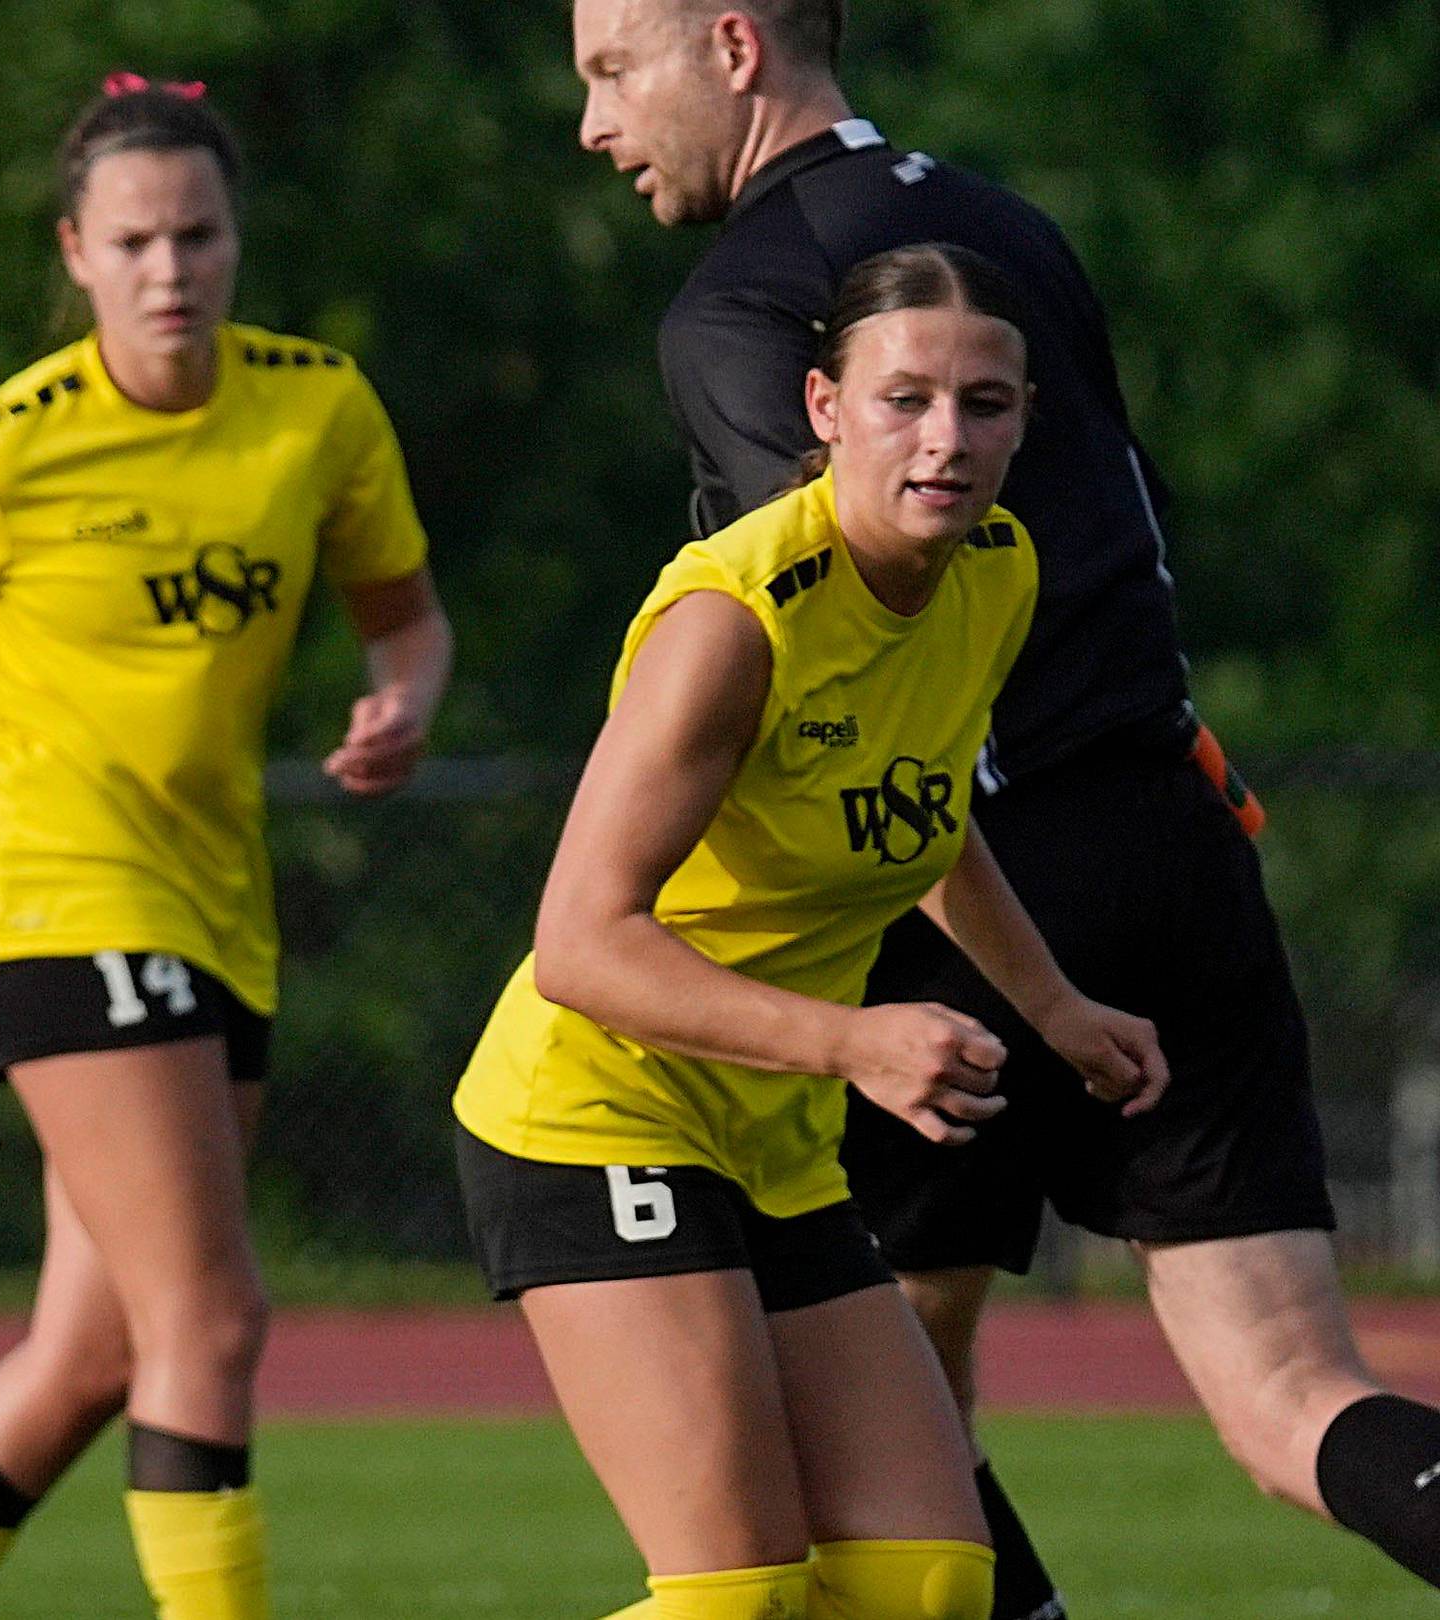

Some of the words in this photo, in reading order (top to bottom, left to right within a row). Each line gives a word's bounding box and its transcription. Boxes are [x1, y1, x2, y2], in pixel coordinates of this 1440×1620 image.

[143, 541, 280, 637] WSR
[840, 756, 957, 866] WSR
[93, 949, 197, 1027] 14
[605, 1164, 677, 1242] 6
